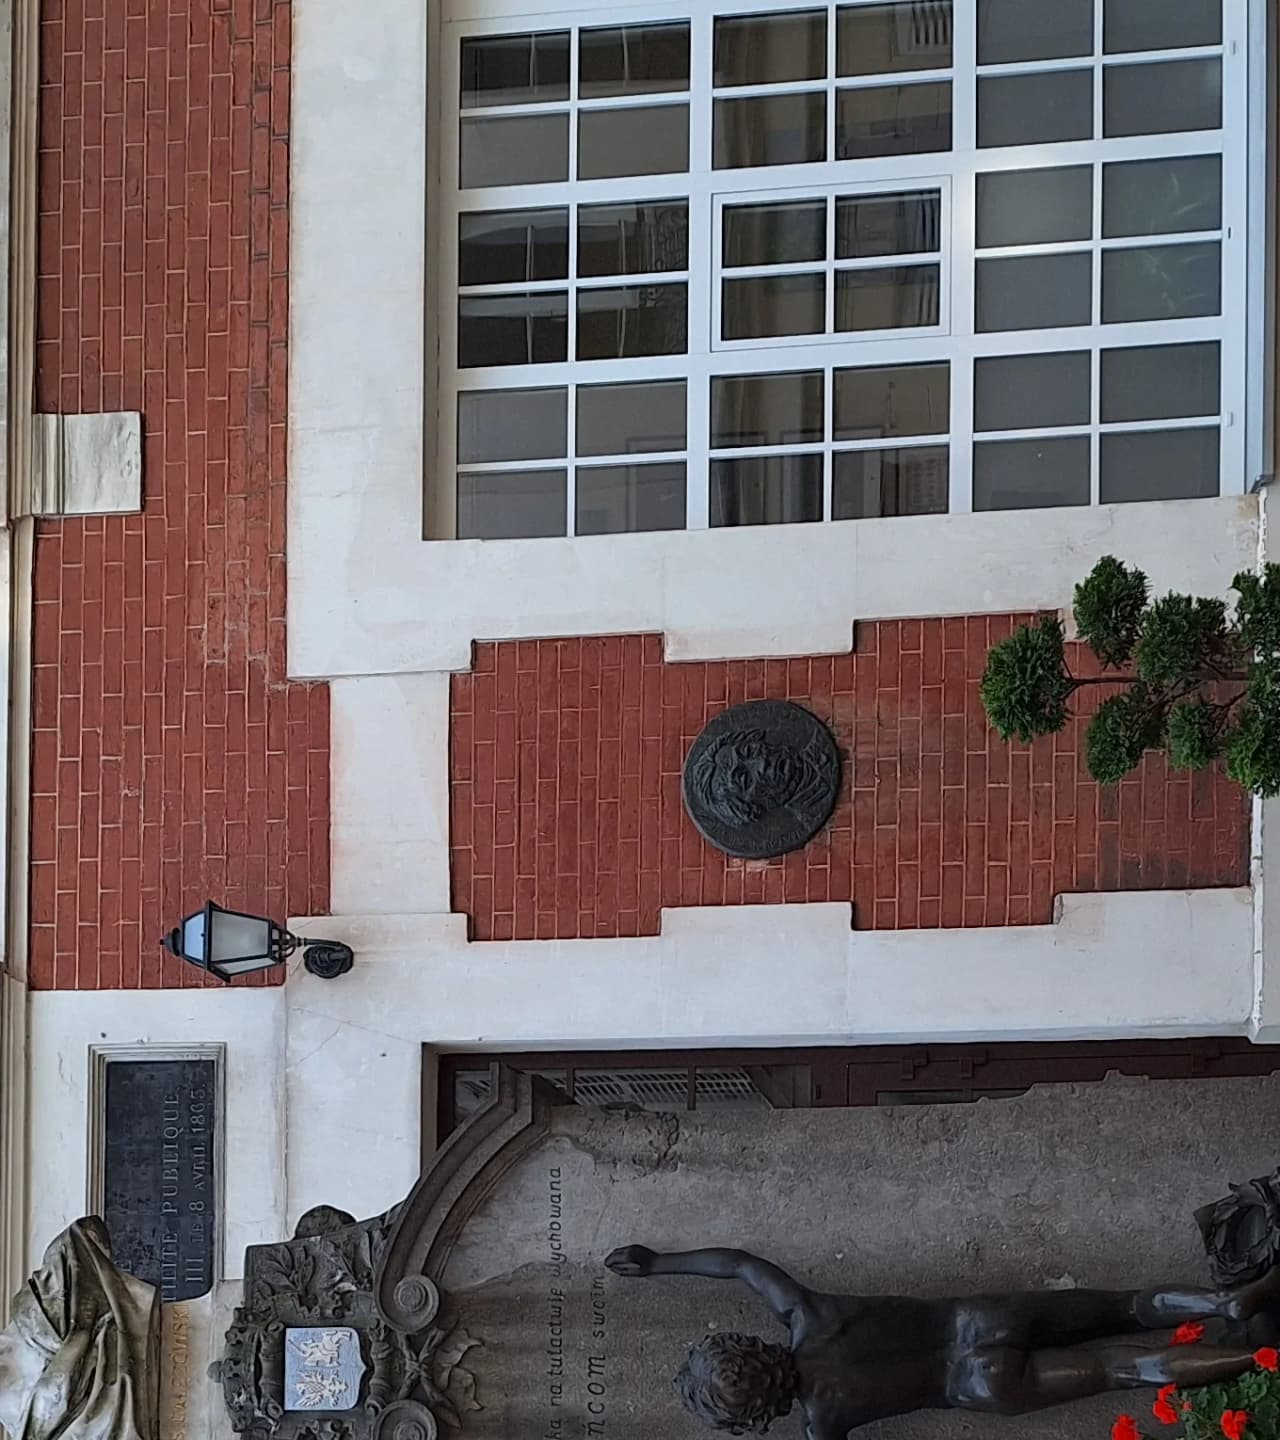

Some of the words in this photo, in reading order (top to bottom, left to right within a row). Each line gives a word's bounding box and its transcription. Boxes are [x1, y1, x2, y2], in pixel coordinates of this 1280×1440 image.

[188, 1200, 206, 1212] 8
[547, 1166, 567, 1278] wychowana
[590, 1275, 606, 1339] swoim
[549, 1383, 563, 1407] na
